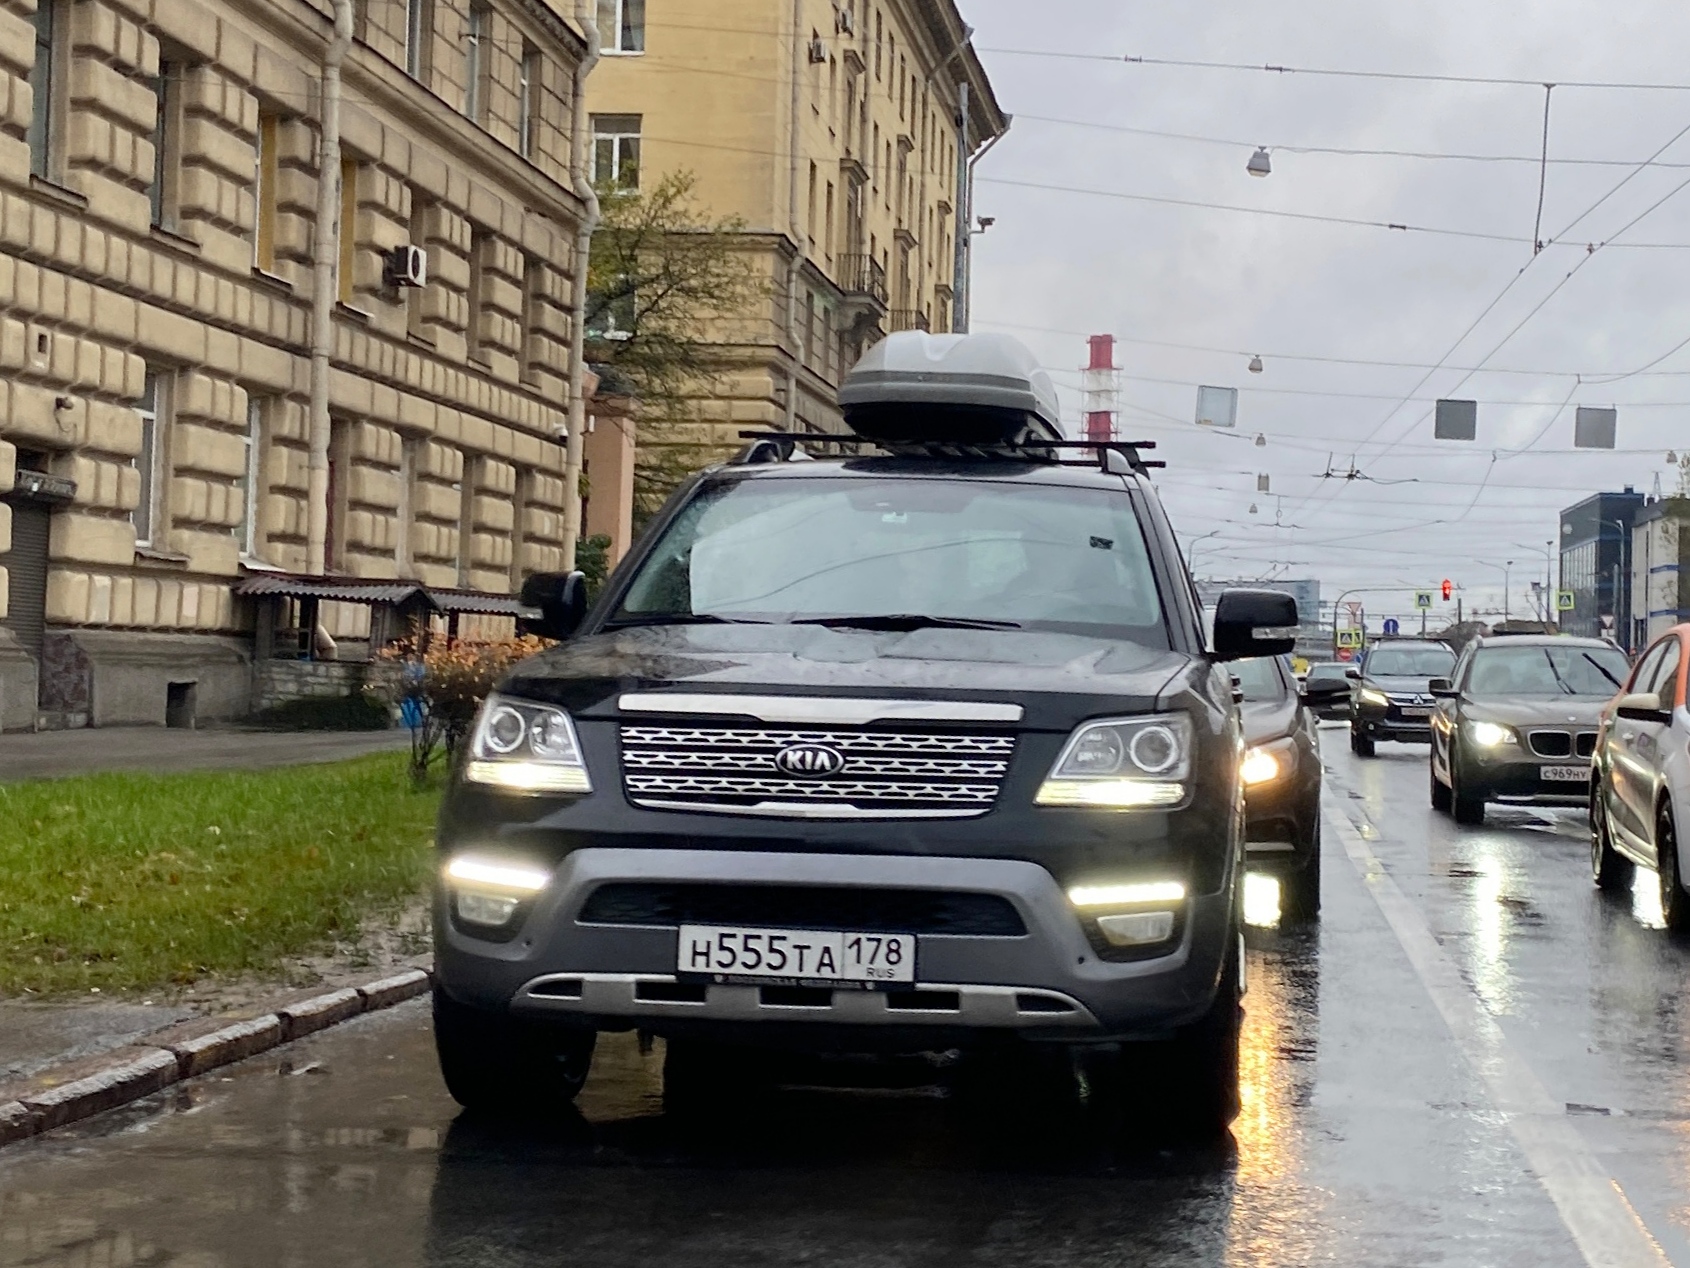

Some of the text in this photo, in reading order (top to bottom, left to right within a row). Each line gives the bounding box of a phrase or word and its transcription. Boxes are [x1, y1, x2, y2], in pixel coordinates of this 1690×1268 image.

[786, 750, 832, 770] KIA
[848, 937, 902, 966] 178
[866, 967, 896, 979] RUS
